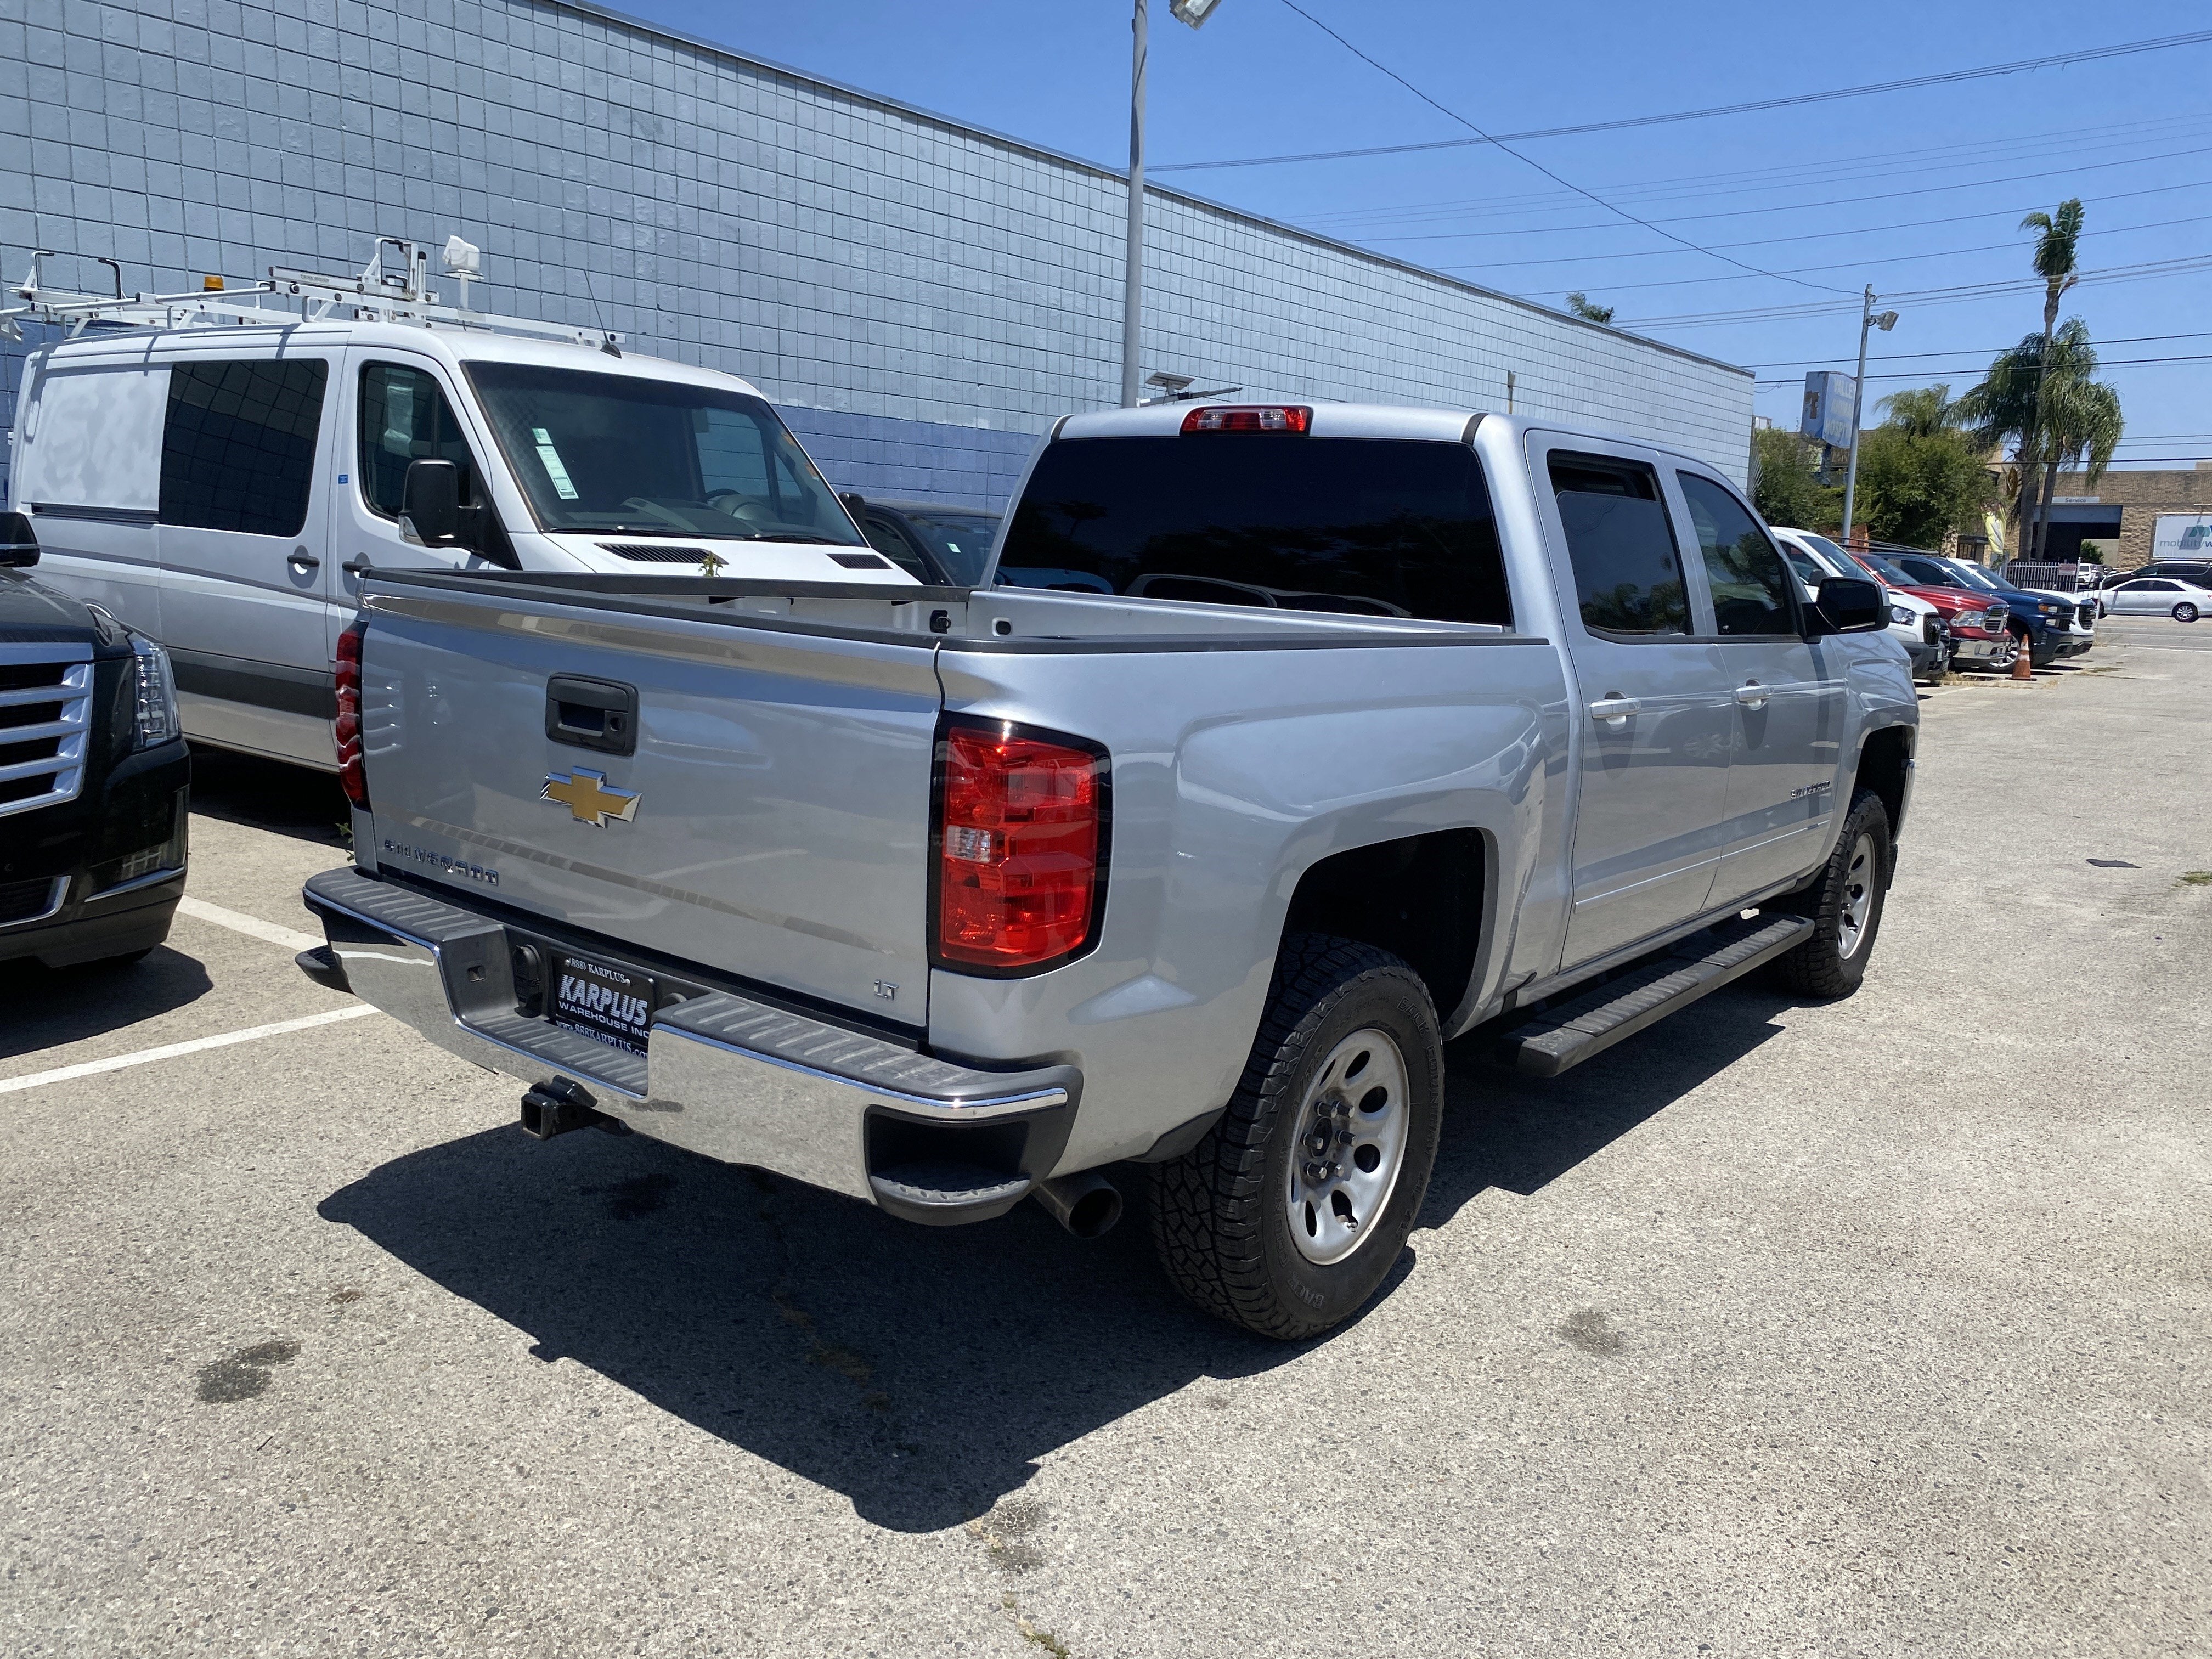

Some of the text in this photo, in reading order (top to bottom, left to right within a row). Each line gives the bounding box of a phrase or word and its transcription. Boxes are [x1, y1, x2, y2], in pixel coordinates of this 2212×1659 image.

[1834, 377, 1855, 399] VALLE
[1830, 398, 1853, 420] ANIMA
[385, 839, 499, 887] SILVERADO
[568, 957, 625, 984] (888) KARPLUS
[558, 974, 648, 1026] KARPLUS
[873, 979, 899, 1001] LT
[558, 1001, 628, 1031] WAREHOUSE
[556, 1020, 648, 1059] www.888KARPLUS.co
